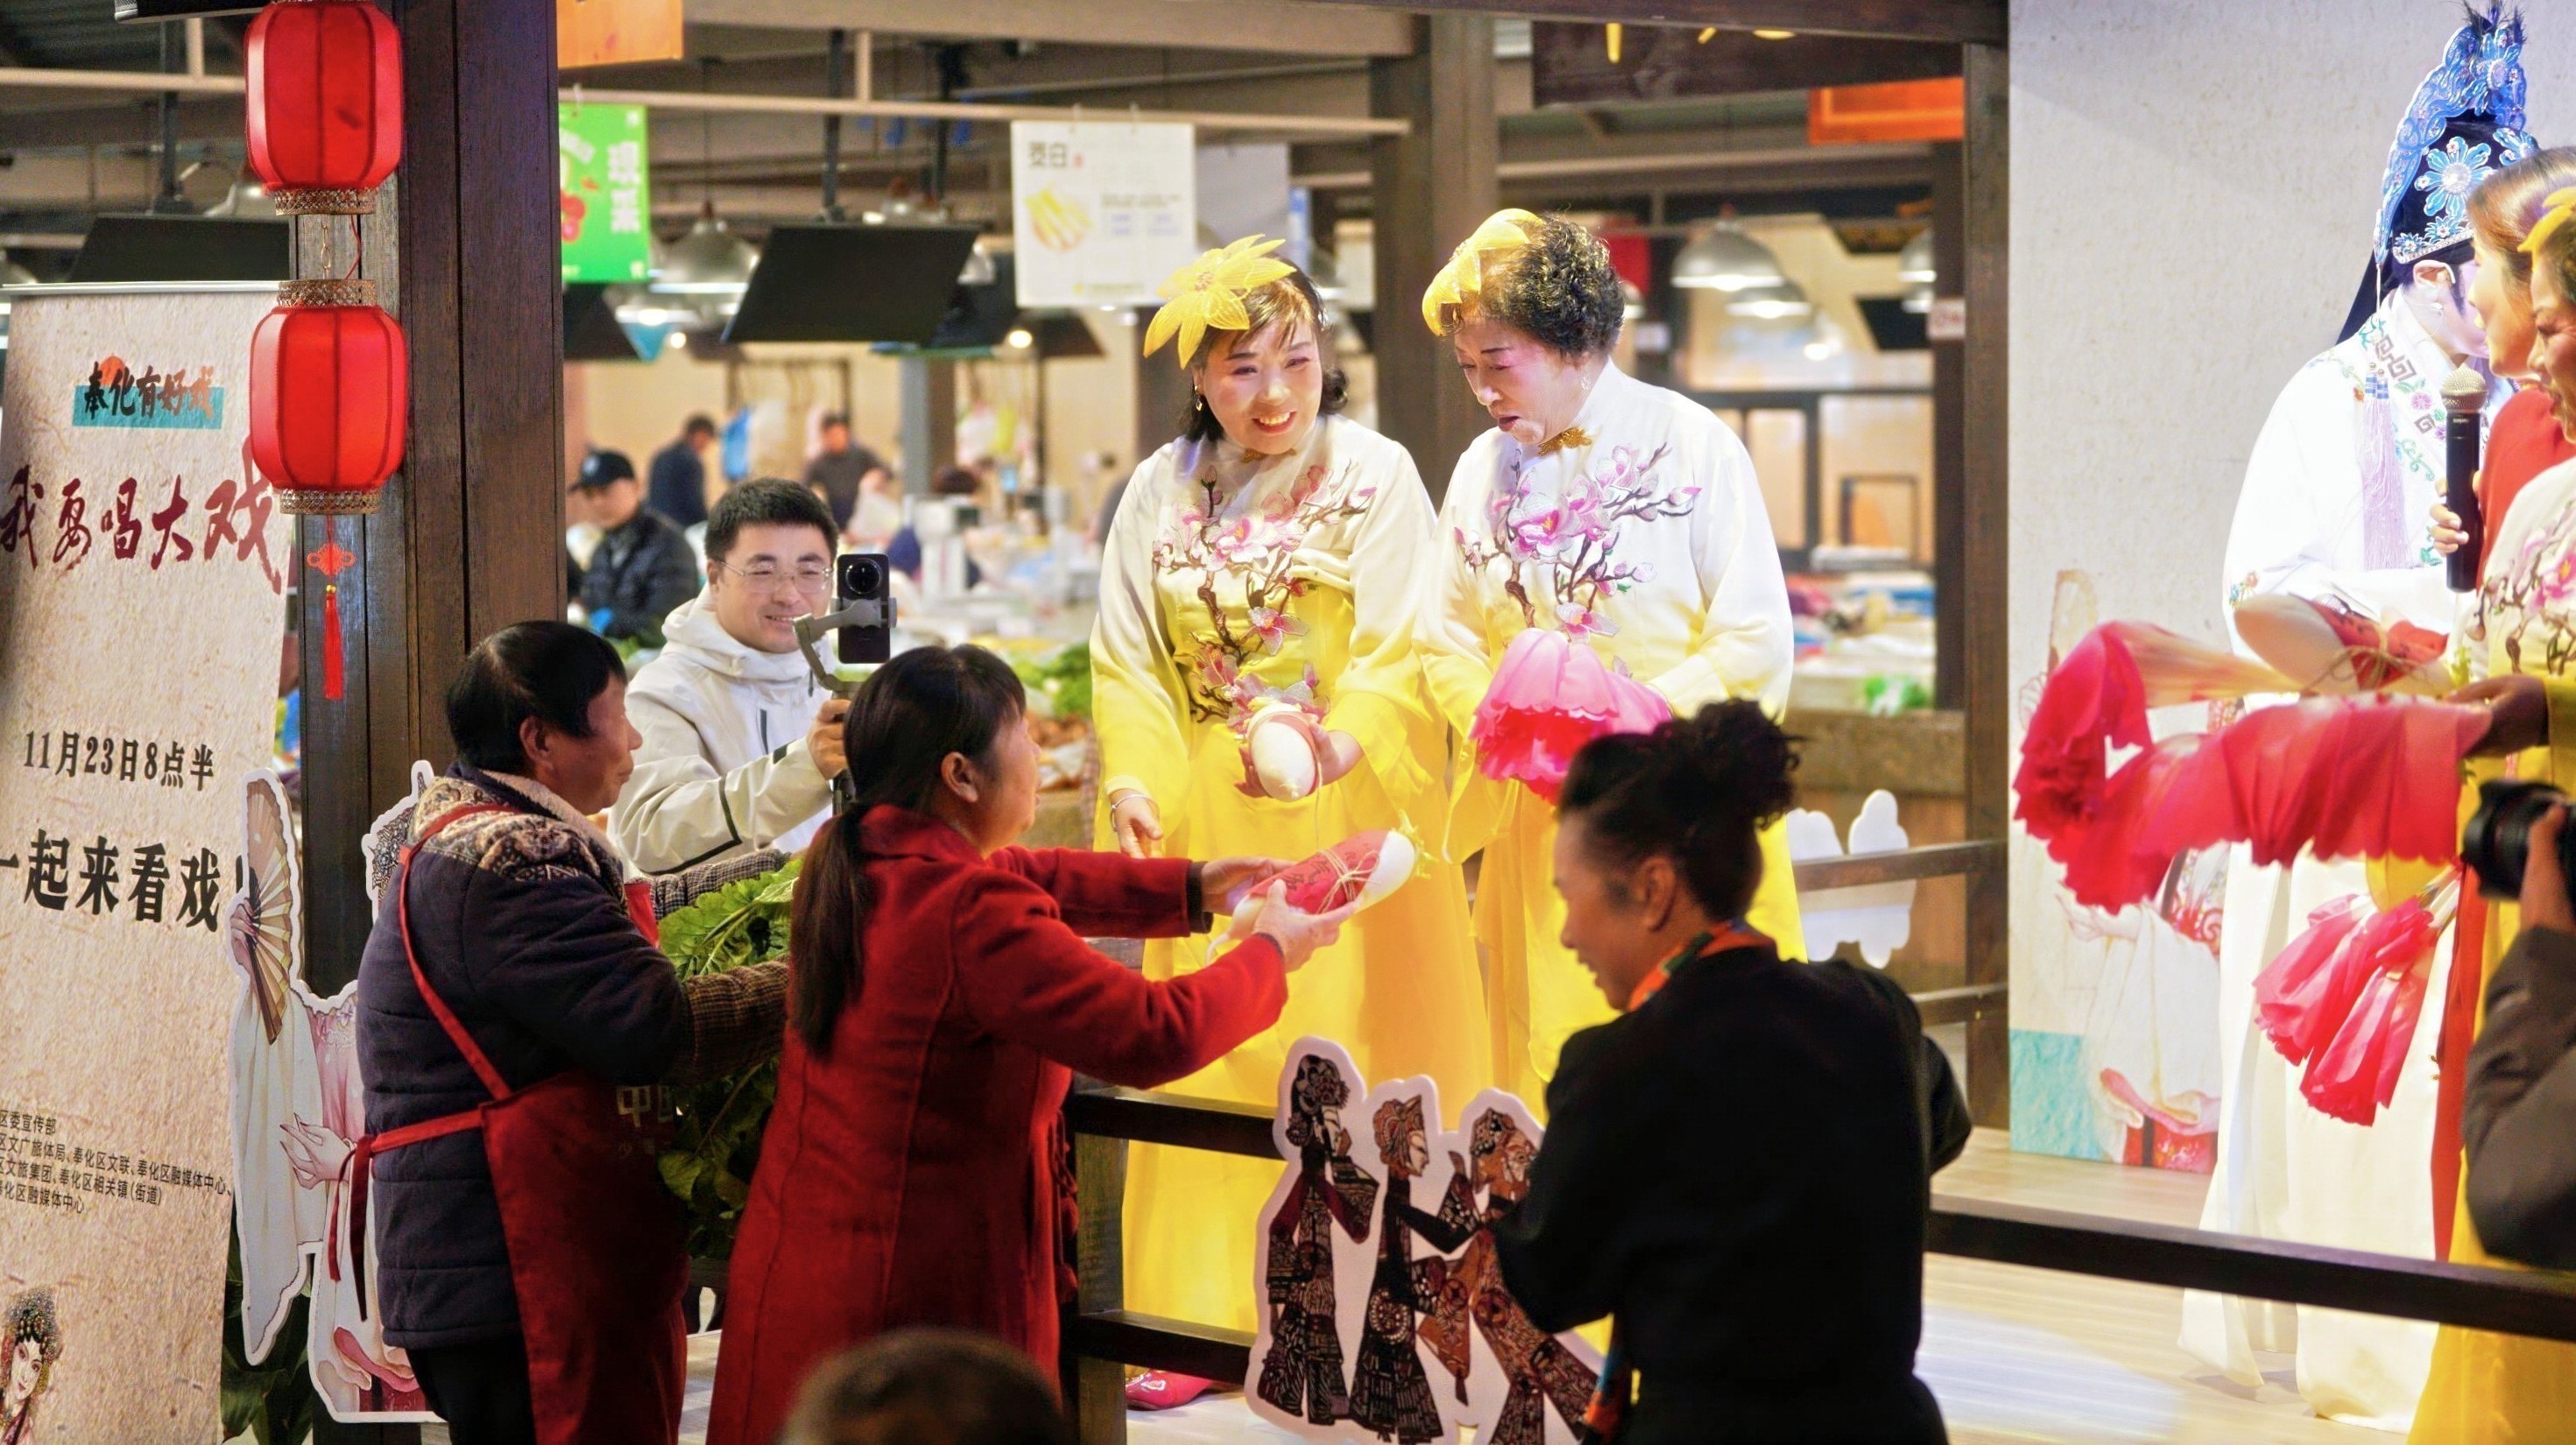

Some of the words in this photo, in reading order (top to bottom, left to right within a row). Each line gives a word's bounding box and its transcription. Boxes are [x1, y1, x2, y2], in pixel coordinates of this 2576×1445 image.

[84, 361, 215, 420] 奉化有好戏
[0, 434, 281, 595] 我要唱大戏
[25, 730, 214, 792] 11月23日8点半
[0, 1180, 85, 1214] 化区融媒体中心
